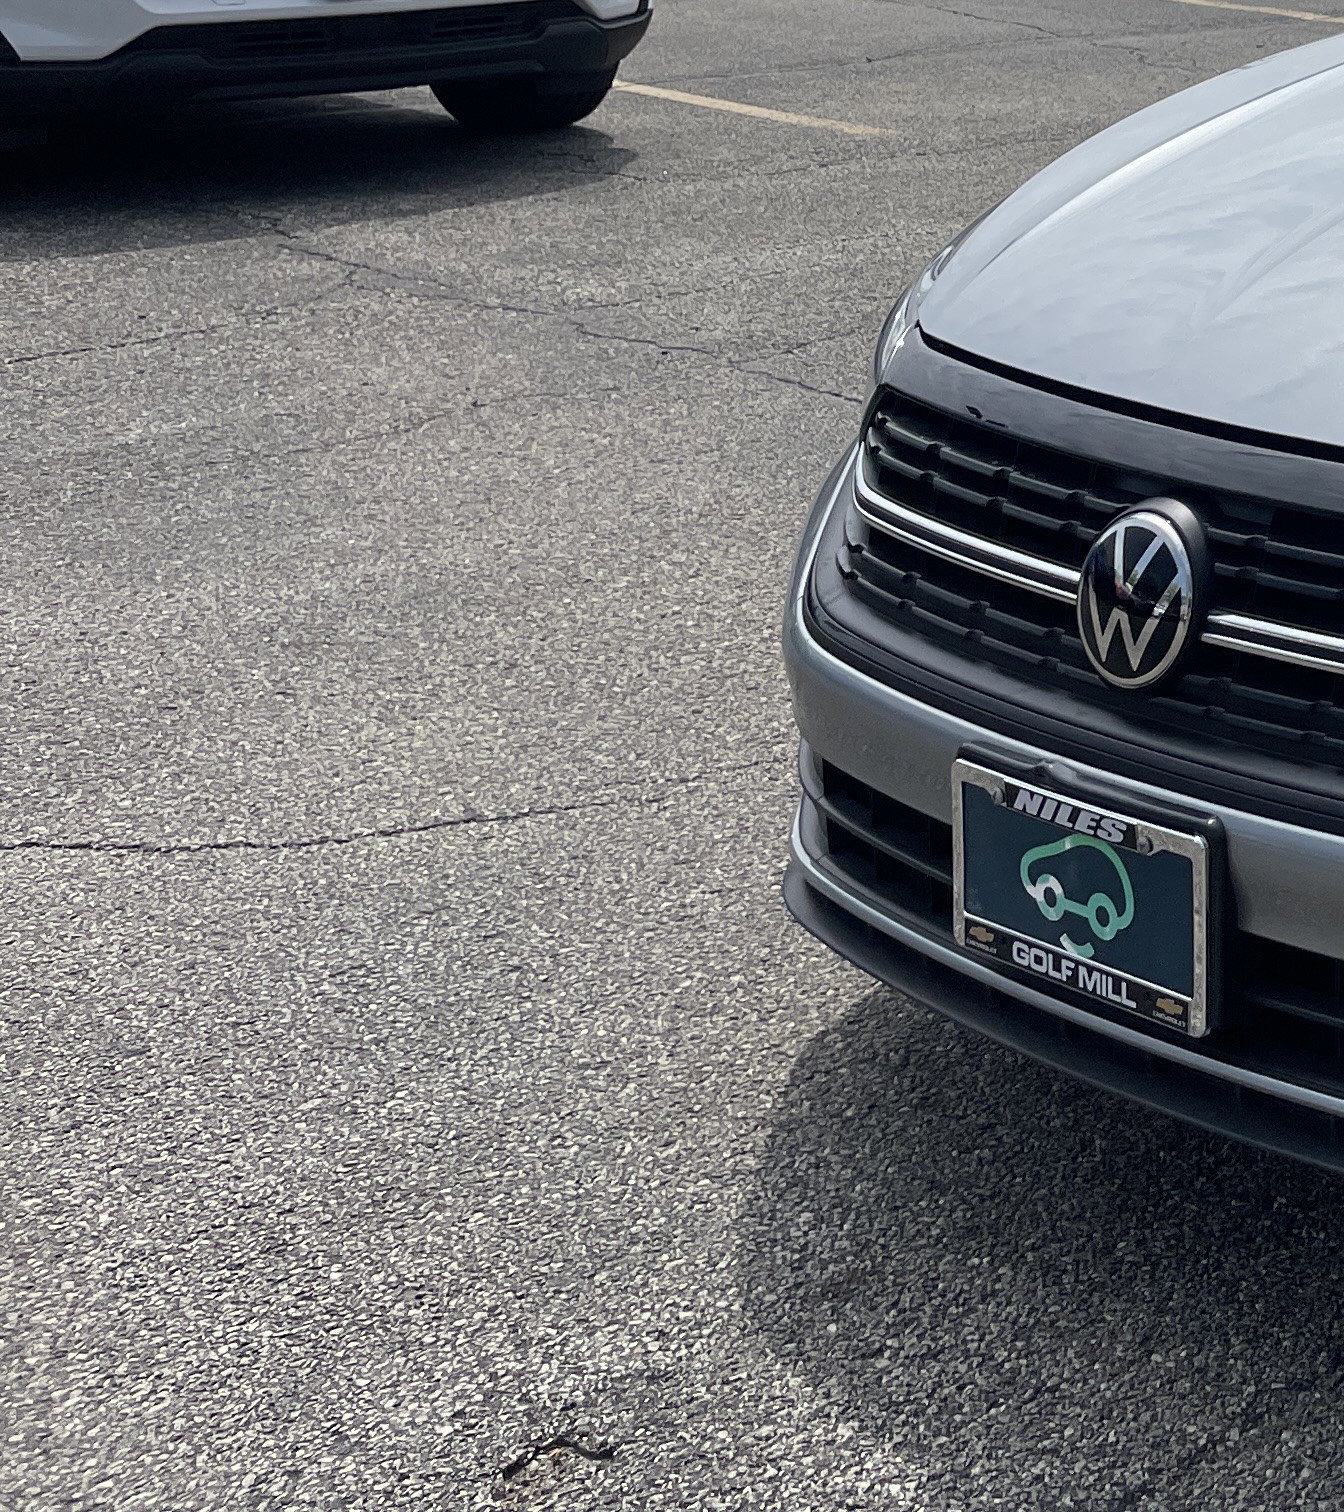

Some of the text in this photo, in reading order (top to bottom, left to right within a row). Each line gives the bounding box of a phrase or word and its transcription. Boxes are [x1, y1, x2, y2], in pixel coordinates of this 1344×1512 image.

[1013, 788, 1128, 844] NILES
[1012, 940, 1138, 1009] GOLF MILL
